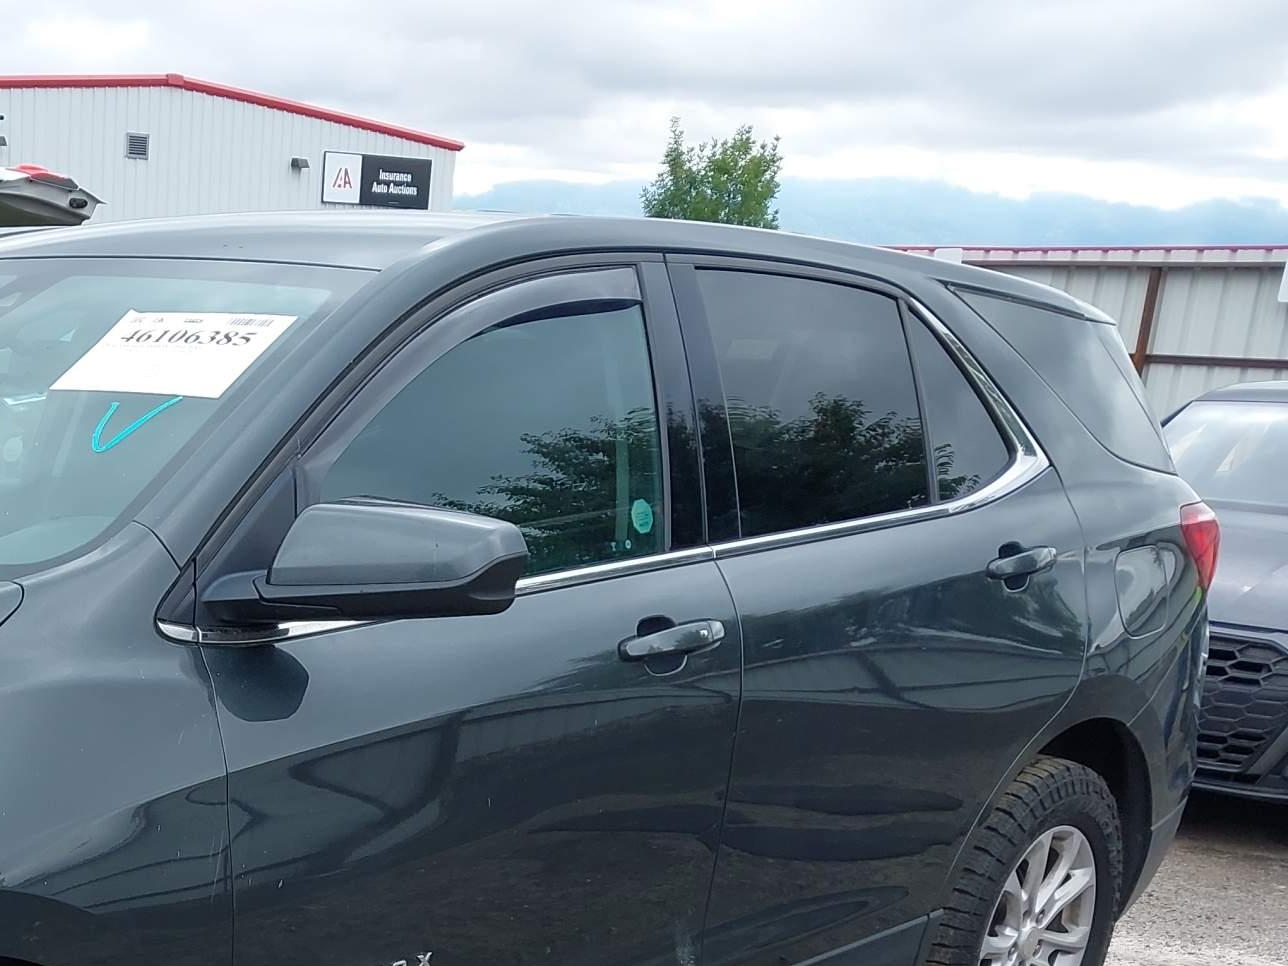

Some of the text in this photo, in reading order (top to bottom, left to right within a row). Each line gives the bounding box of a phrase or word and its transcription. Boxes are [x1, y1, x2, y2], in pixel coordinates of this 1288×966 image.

[379, 168, 412, 182] Insurance
[371, 181, 418, 196] Auto Auctions
[120, 328, 258, 347] 46106385
